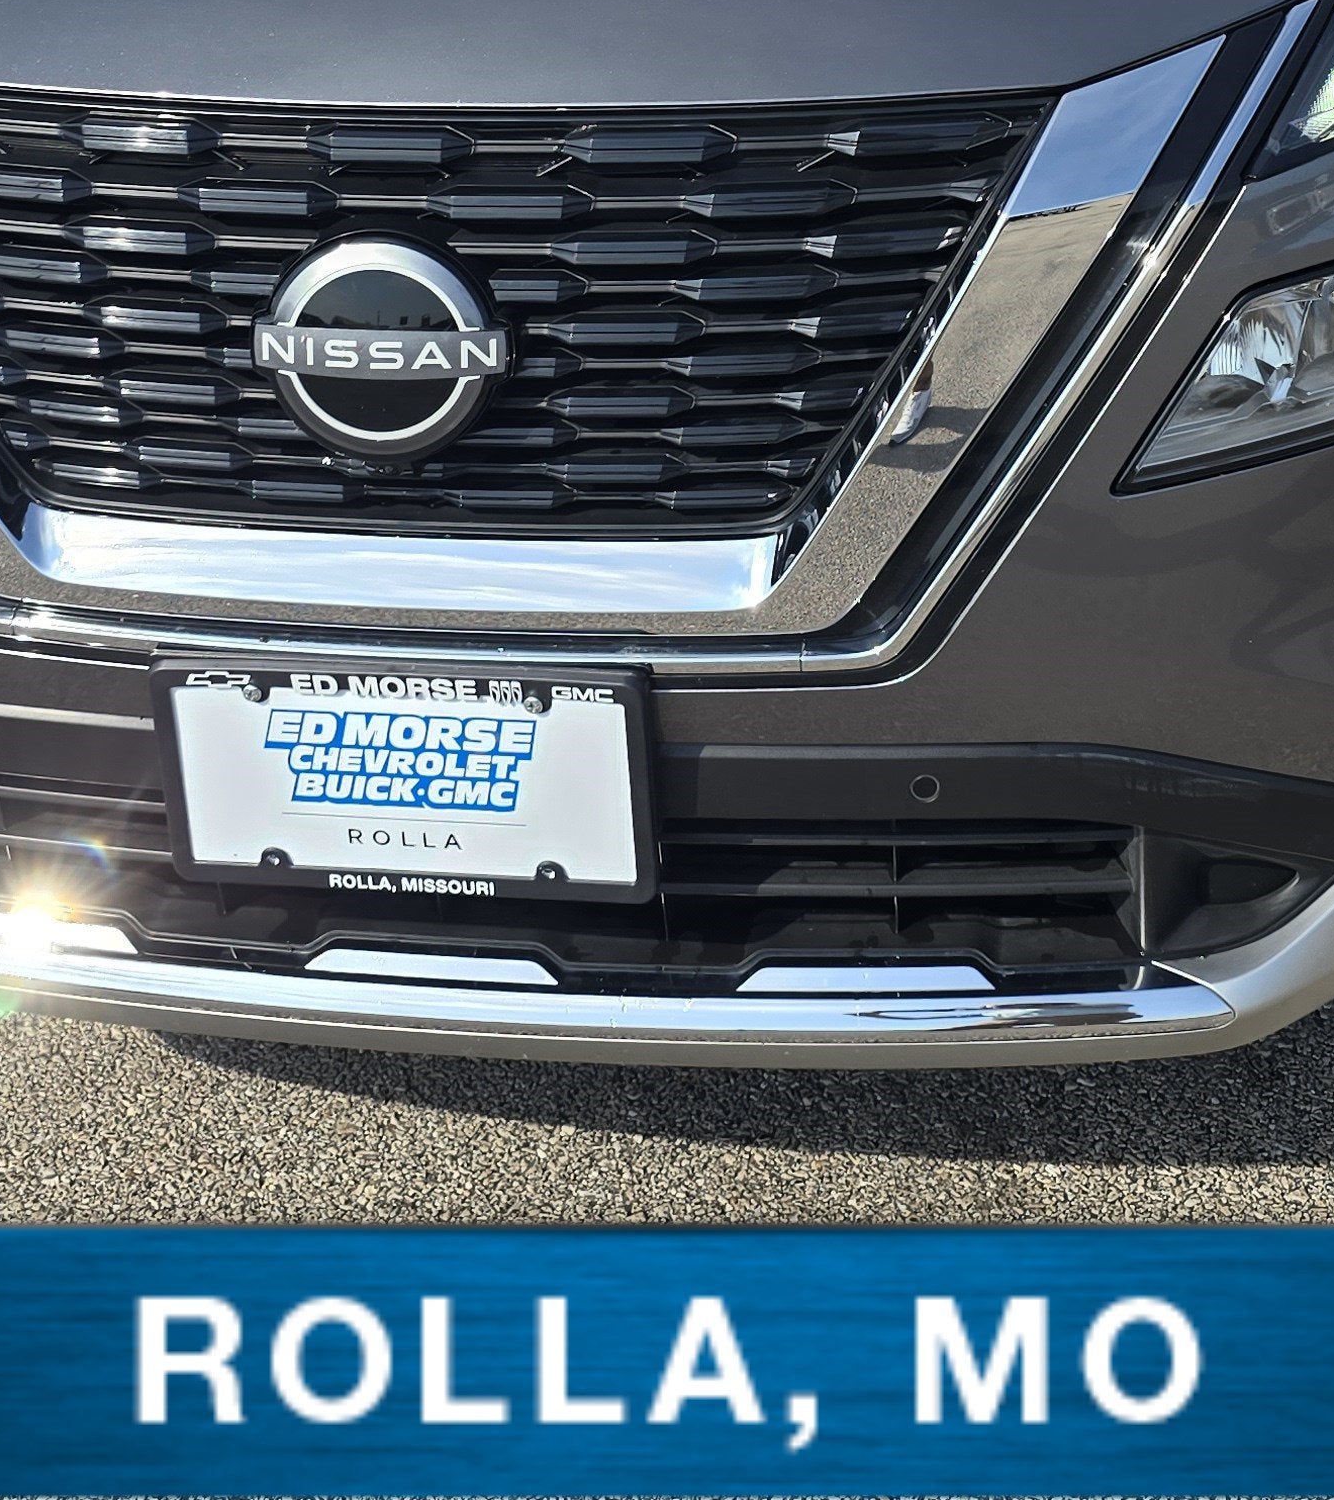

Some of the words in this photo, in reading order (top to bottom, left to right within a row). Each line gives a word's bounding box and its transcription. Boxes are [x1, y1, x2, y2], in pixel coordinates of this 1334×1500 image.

[260, 331, 497, 370] NISSAN
[290, 673, 339, 696] ED
[347, 675, 478, 700] MORSE
[551, 685, 615, 703] GMC
[267, 710, 338, 744] ED
[341, 713, 535, 754] MORSE
[290, 744, 515, 779] CHEVROLET
[348, 828, 463, 850] ROLLA
[328, 873, 397, 893] ROLLA,
[401, 876, 495, 897] MISSOURI
